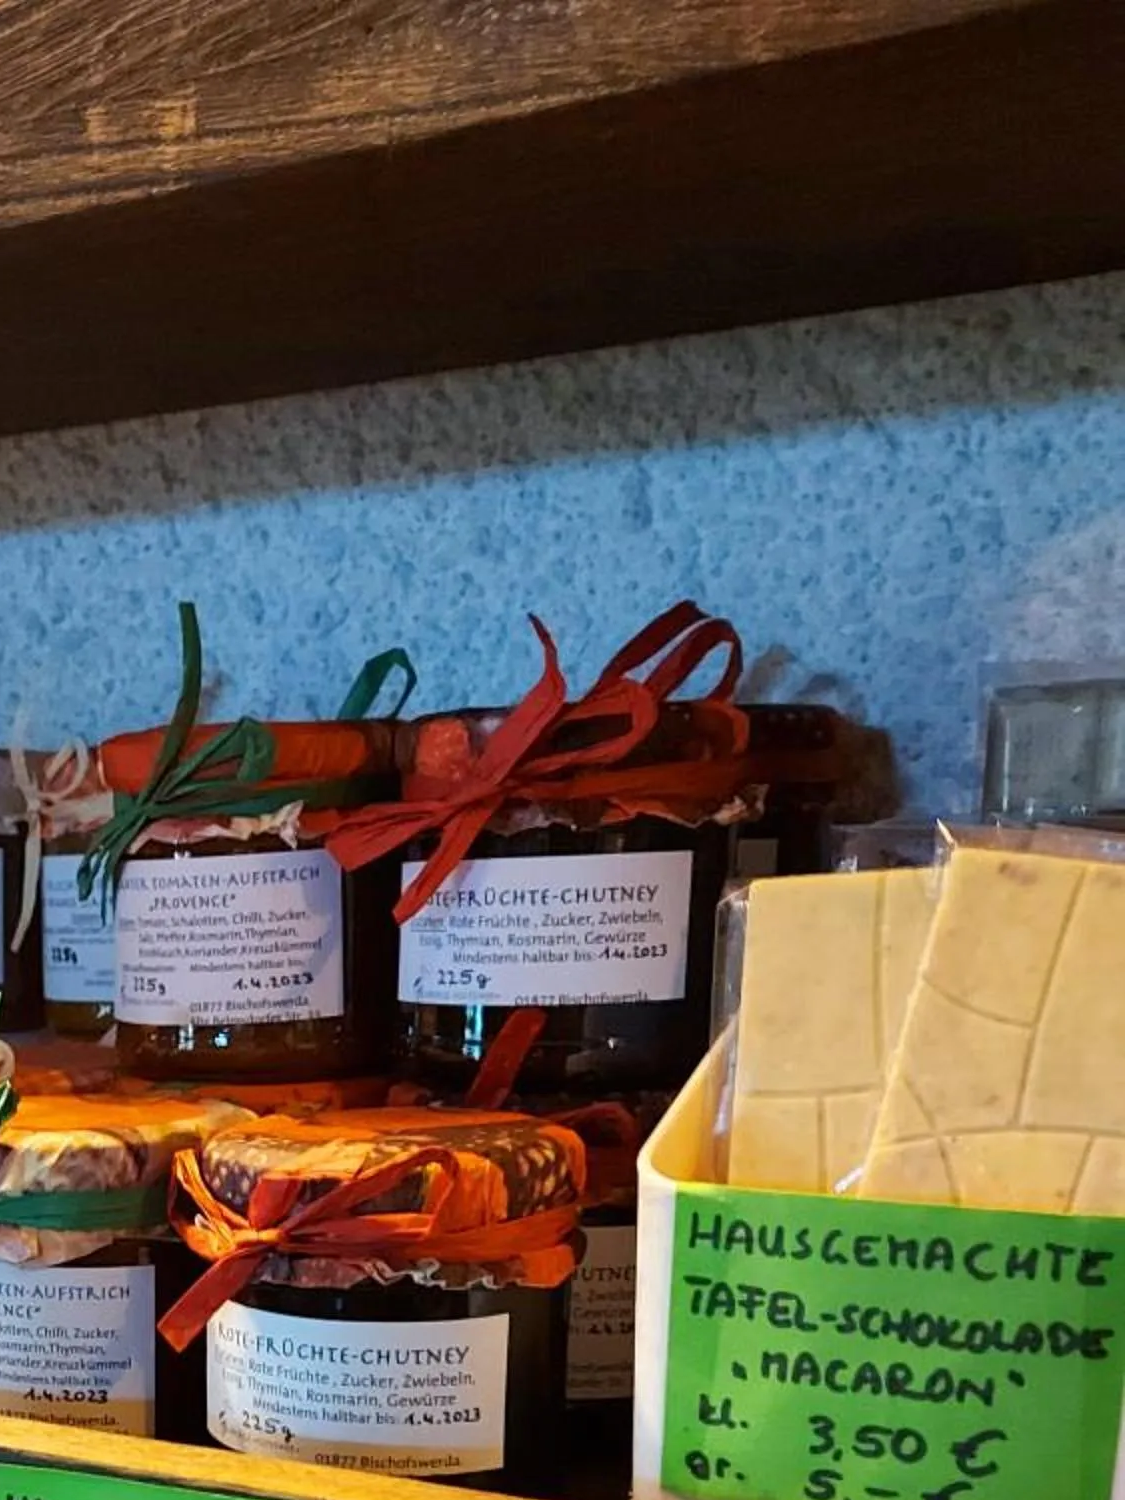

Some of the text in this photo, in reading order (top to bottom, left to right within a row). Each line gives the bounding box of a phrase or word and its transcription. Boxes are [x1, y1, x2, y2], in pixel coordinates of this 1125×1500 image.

[424, 883, 662, 908] OTE-FRÜCHTE-CHUTNEY
[688, 1211, 1116, 1288] HAUSGEMACHTE
[684, 1275, 1116, 1359] TAFEL-SCHOKOLADE
[24, 1387, 108, 1404] 1.4.2023
[807, 1414, 928, 1464] 3,50
[949, 1428, 1009, 1479] €
